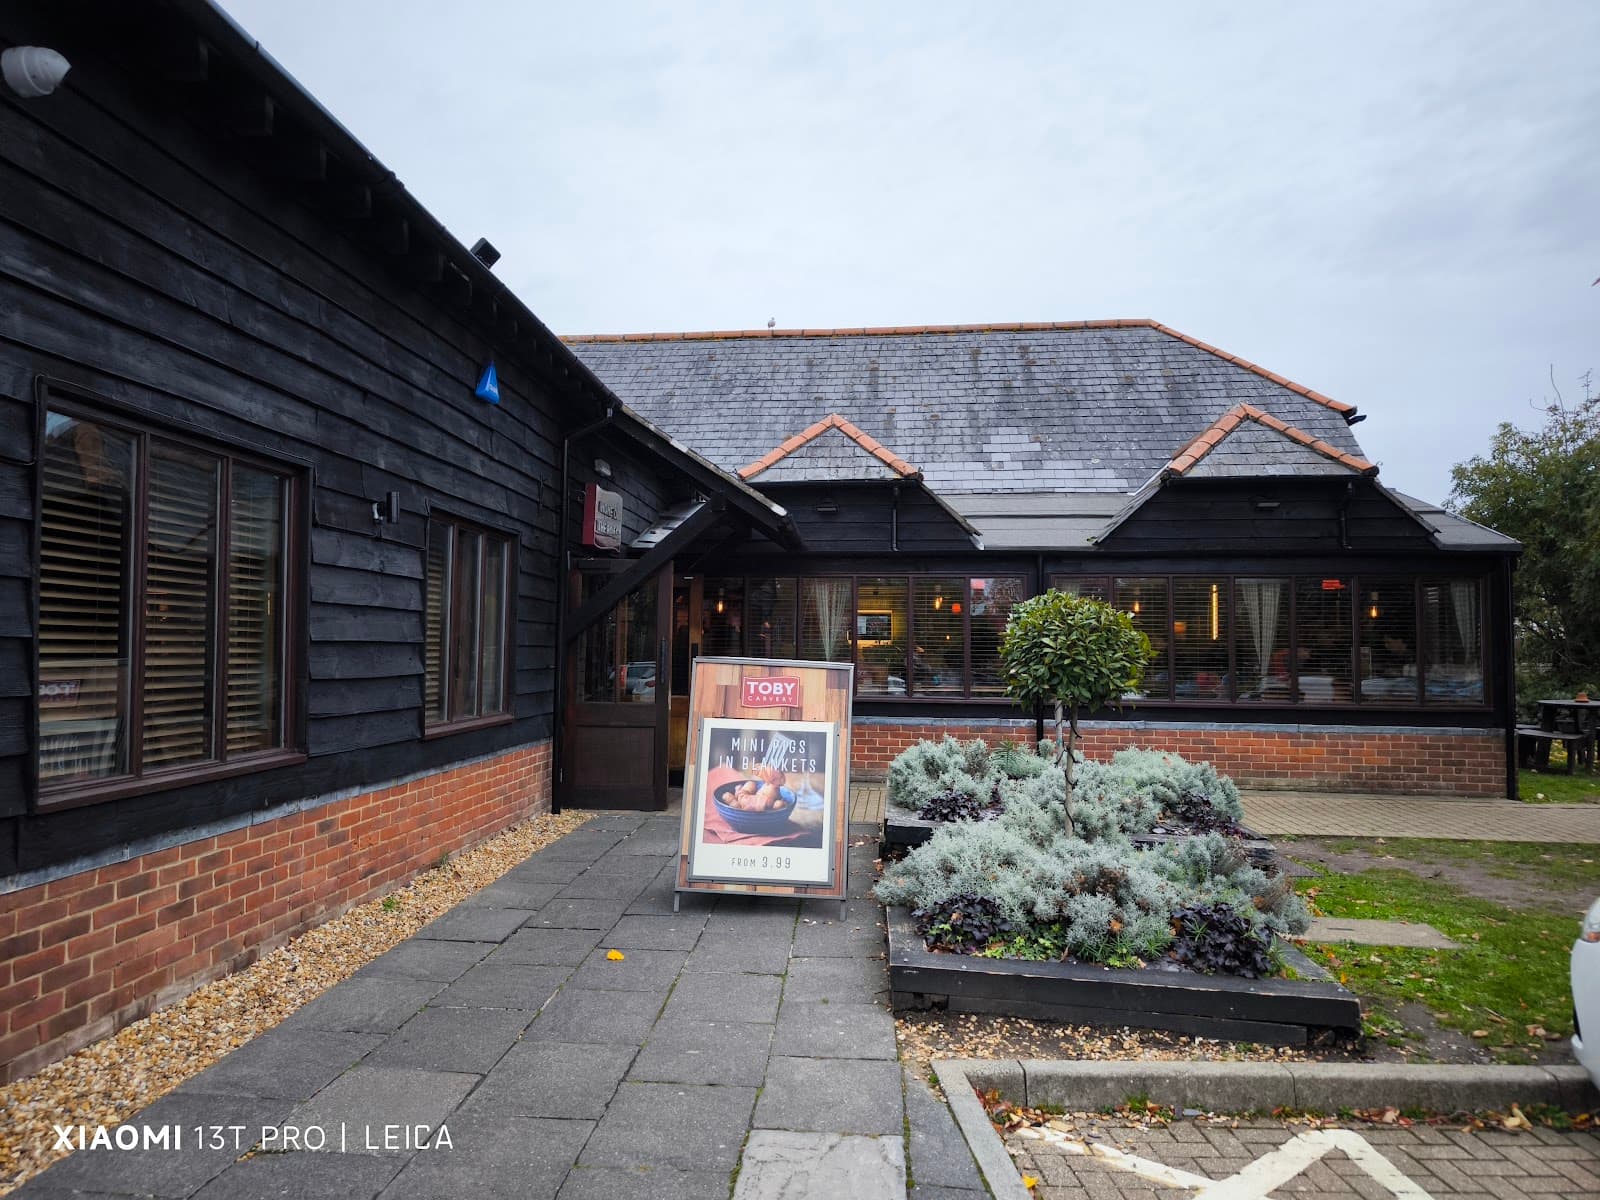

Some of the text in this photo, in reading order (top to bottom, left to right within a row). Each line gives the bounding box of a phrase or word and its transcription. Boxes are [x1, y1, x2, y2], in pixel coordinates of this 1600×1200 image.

[746, 681, 797, 696] TOBY
[731, 737, 765, 752] MINI
[719, 755, 816, 773] IN BLANKETS
[731, 856, 791, 869] FROM 3.99
